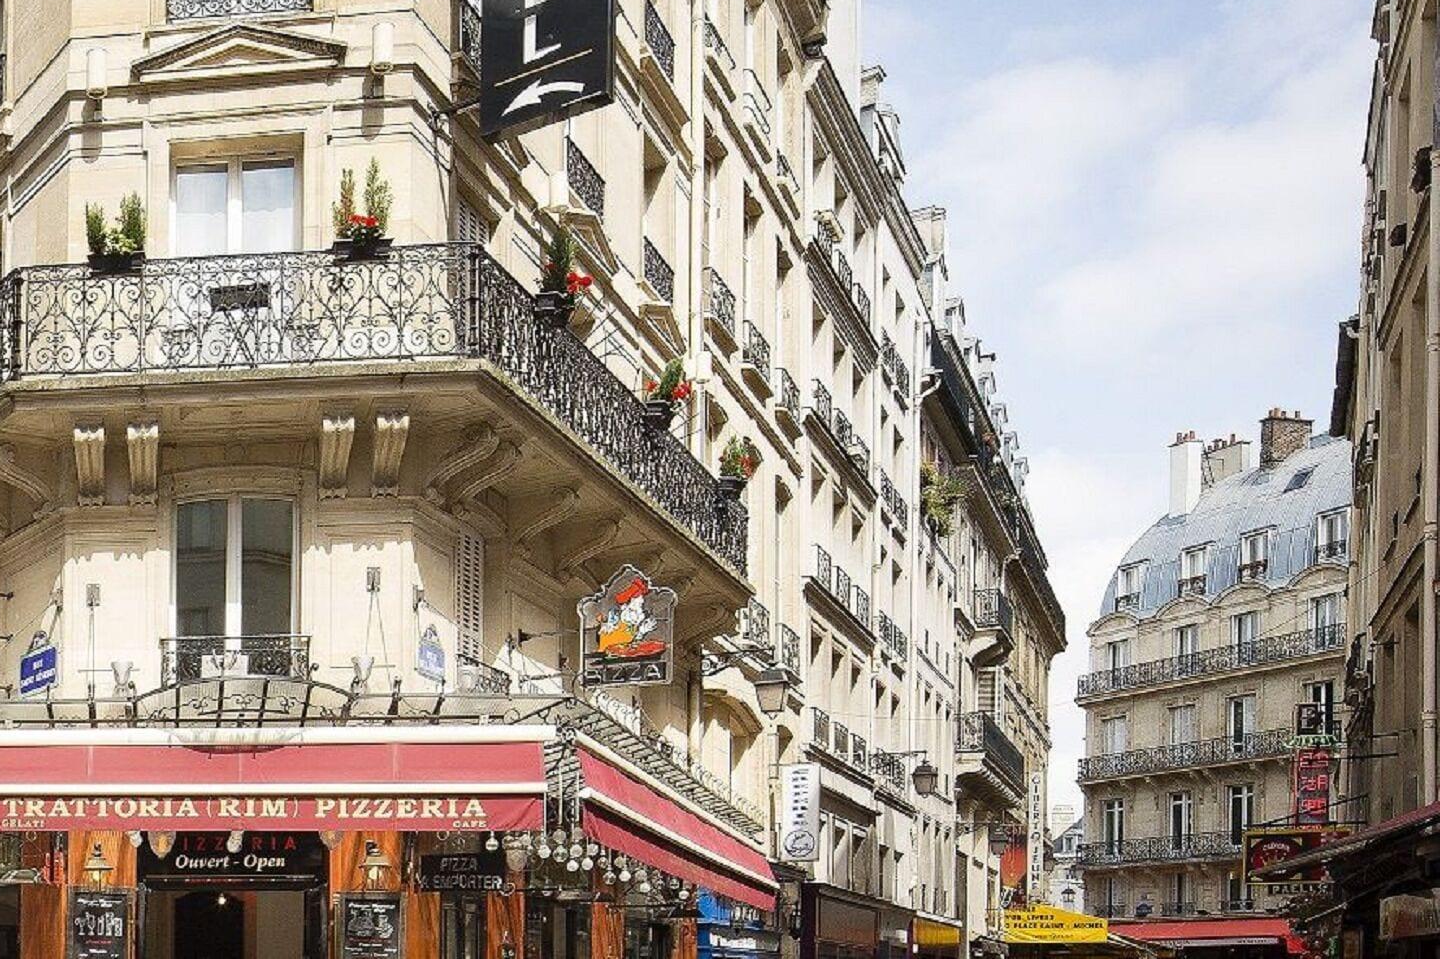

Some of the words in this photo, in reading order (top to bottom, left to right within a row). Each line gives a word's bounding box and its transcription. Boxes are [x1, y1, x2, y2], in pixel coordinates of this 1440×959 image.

[2, 798, 198, 818] TRATTORIA
[315, 798, 487, 819] PIZZERIA
[175, 854, 230, 869] Ouvert
[243, 854, 286, 872] Open
[440, 857, 478, 872] PIZZA
